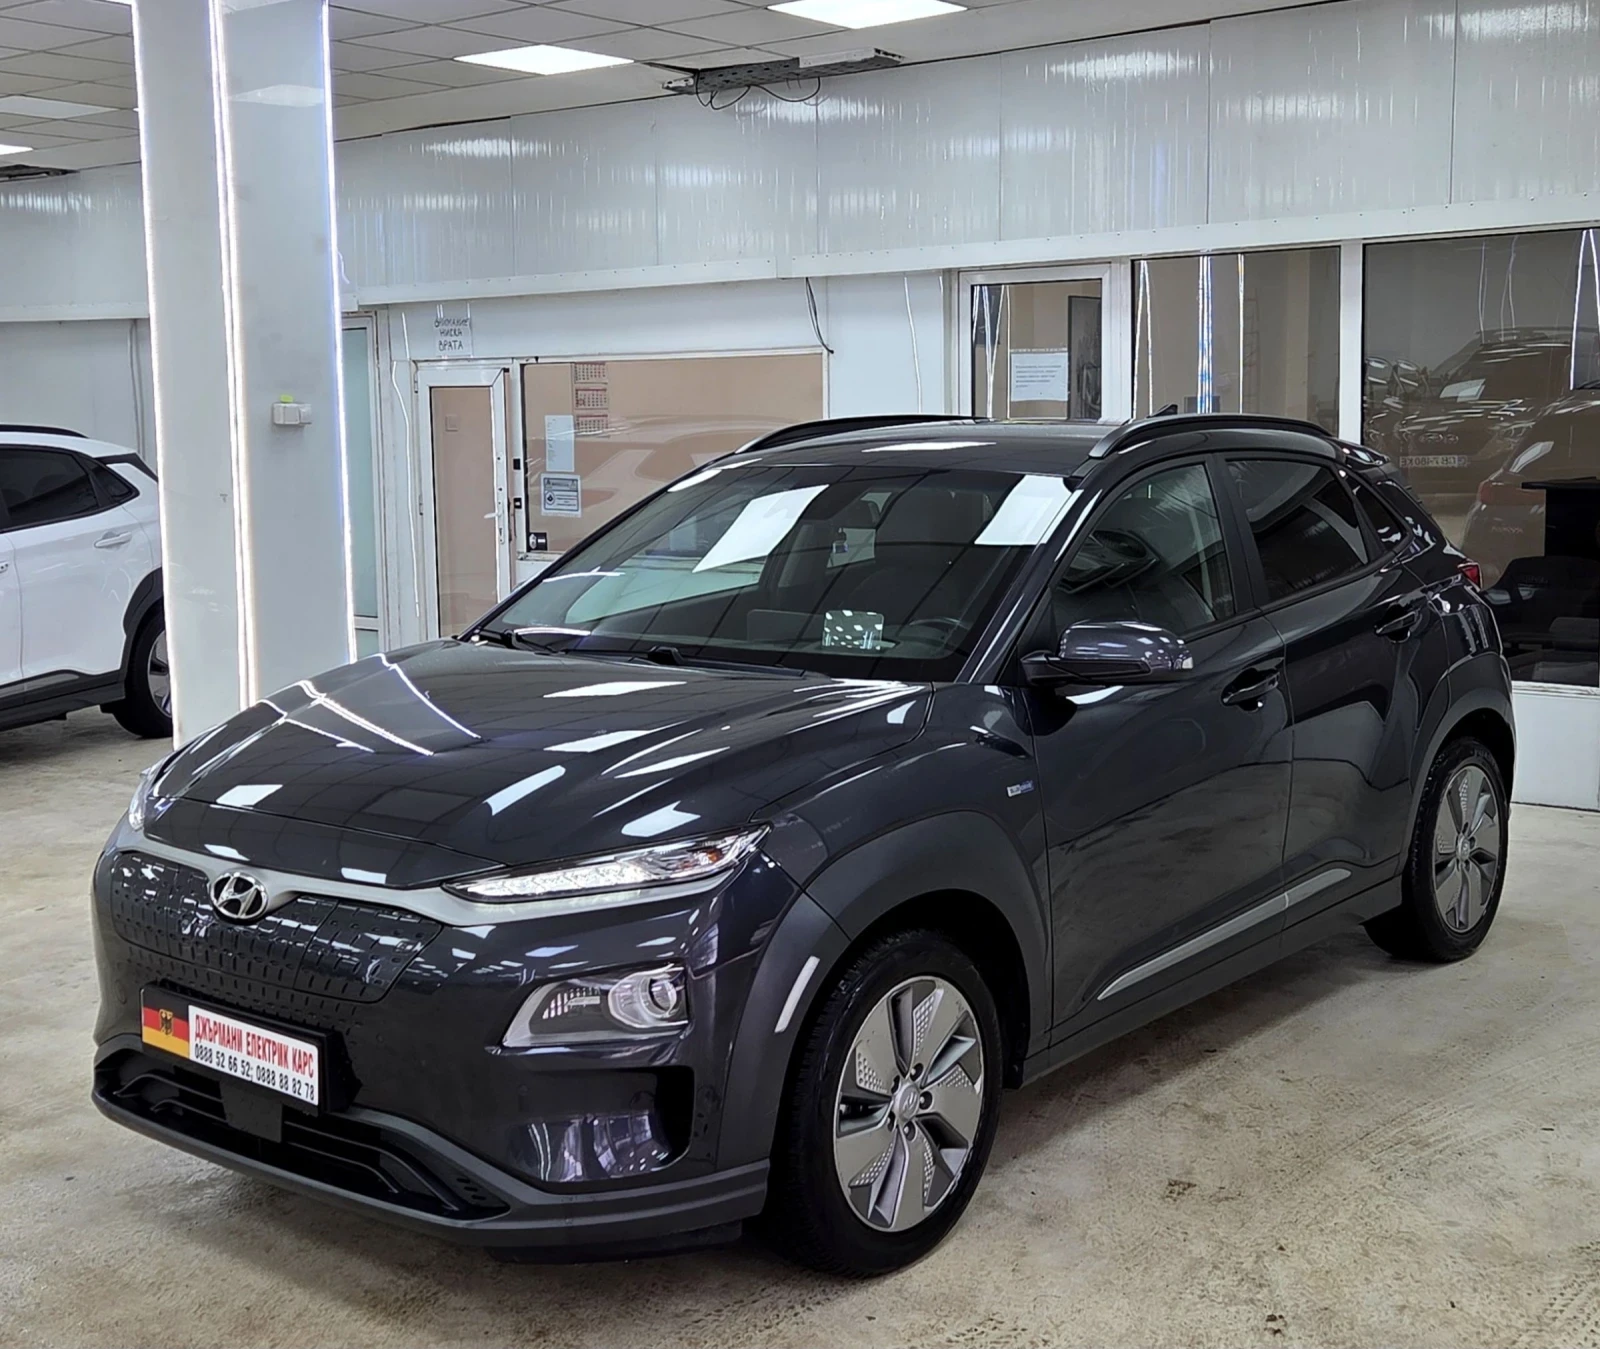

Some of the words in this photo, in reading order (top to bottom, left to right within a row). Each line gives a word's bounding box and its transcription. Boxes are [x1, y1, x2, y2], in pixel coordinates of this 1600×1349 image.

[195, 1014, 243, 1053] ДЖЪРМАНИ
[246, 1032, 289, 1070] ЕЛЕКТРИК
[292, 1047, 314, 1079] КАРС
[195, 1043, 213, 1064] 0888
[216, 1050, 225, 1069] 52
[228, 1055, 238, 1073] 66
[256, 1065, 276, 1087] 0888
[279, 1073, 289, 1091] 88
[292, 1078, 302, 1096] 82
[304, 1082, 315, 1101] 78
